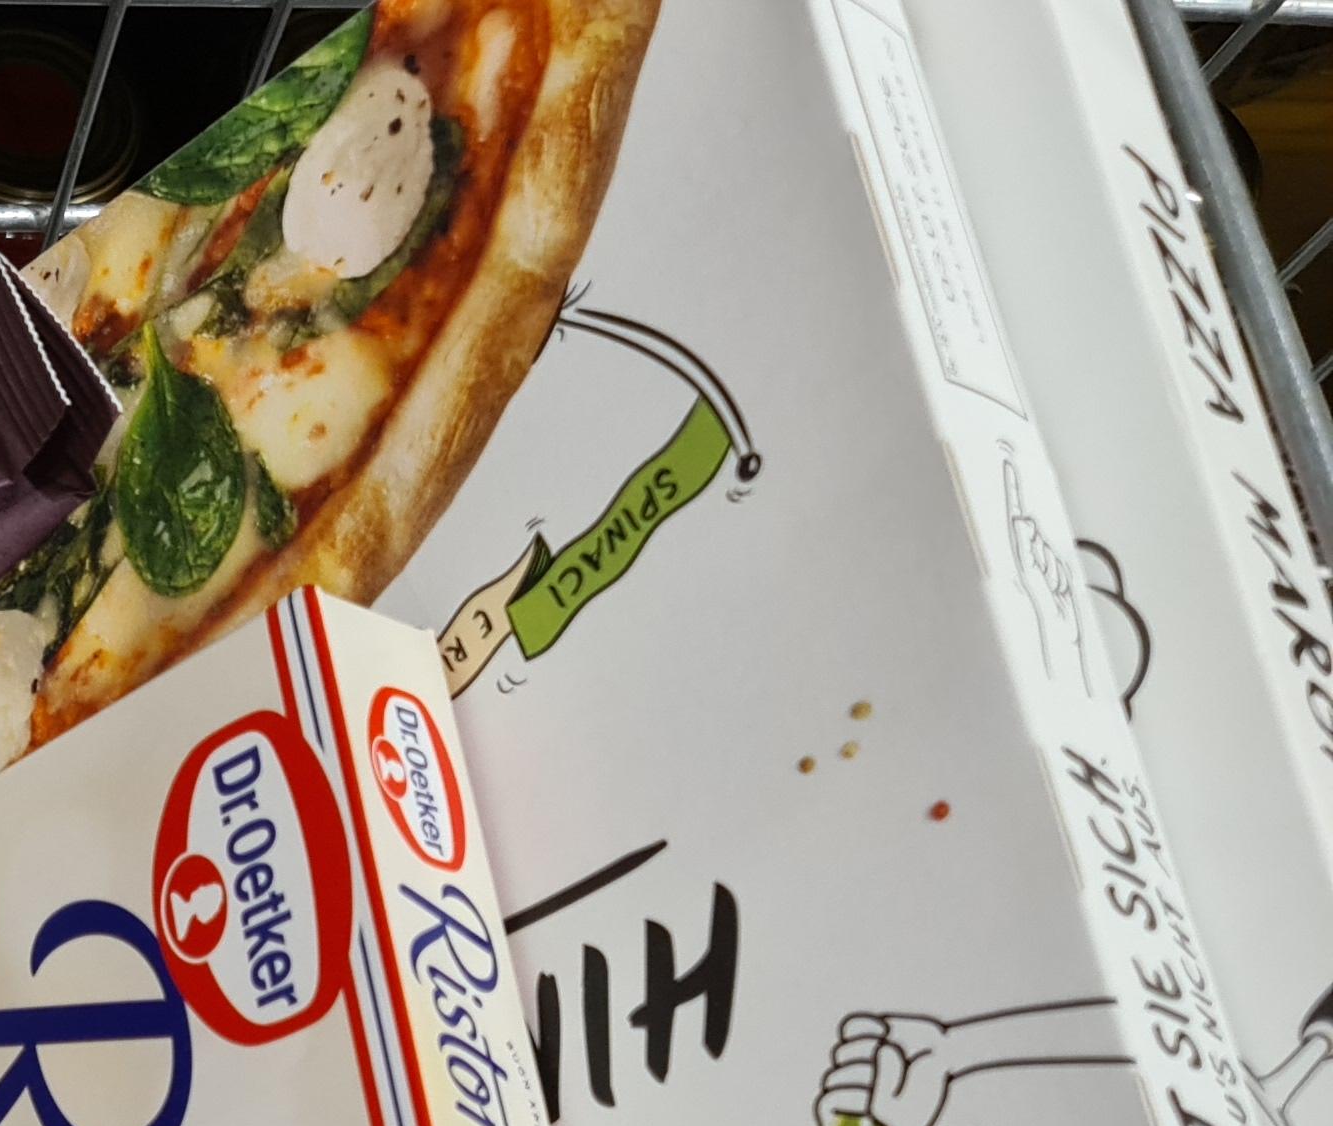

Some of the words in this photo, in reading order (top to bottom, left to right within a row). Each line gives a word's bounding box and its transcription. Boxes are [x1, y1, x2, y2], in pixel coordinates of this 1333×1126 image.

[1120, 143, 1246, 424] PIZZA
[547, 467, 678, 608] SPINACI
[393, 704, 447, 858] Dr.Oetker
[212, 744, 300, 1010] Dr.Oetker
[1131, 955, 1205, 1071] SIE
[1155, 886, 1224, 1042] NICHT
